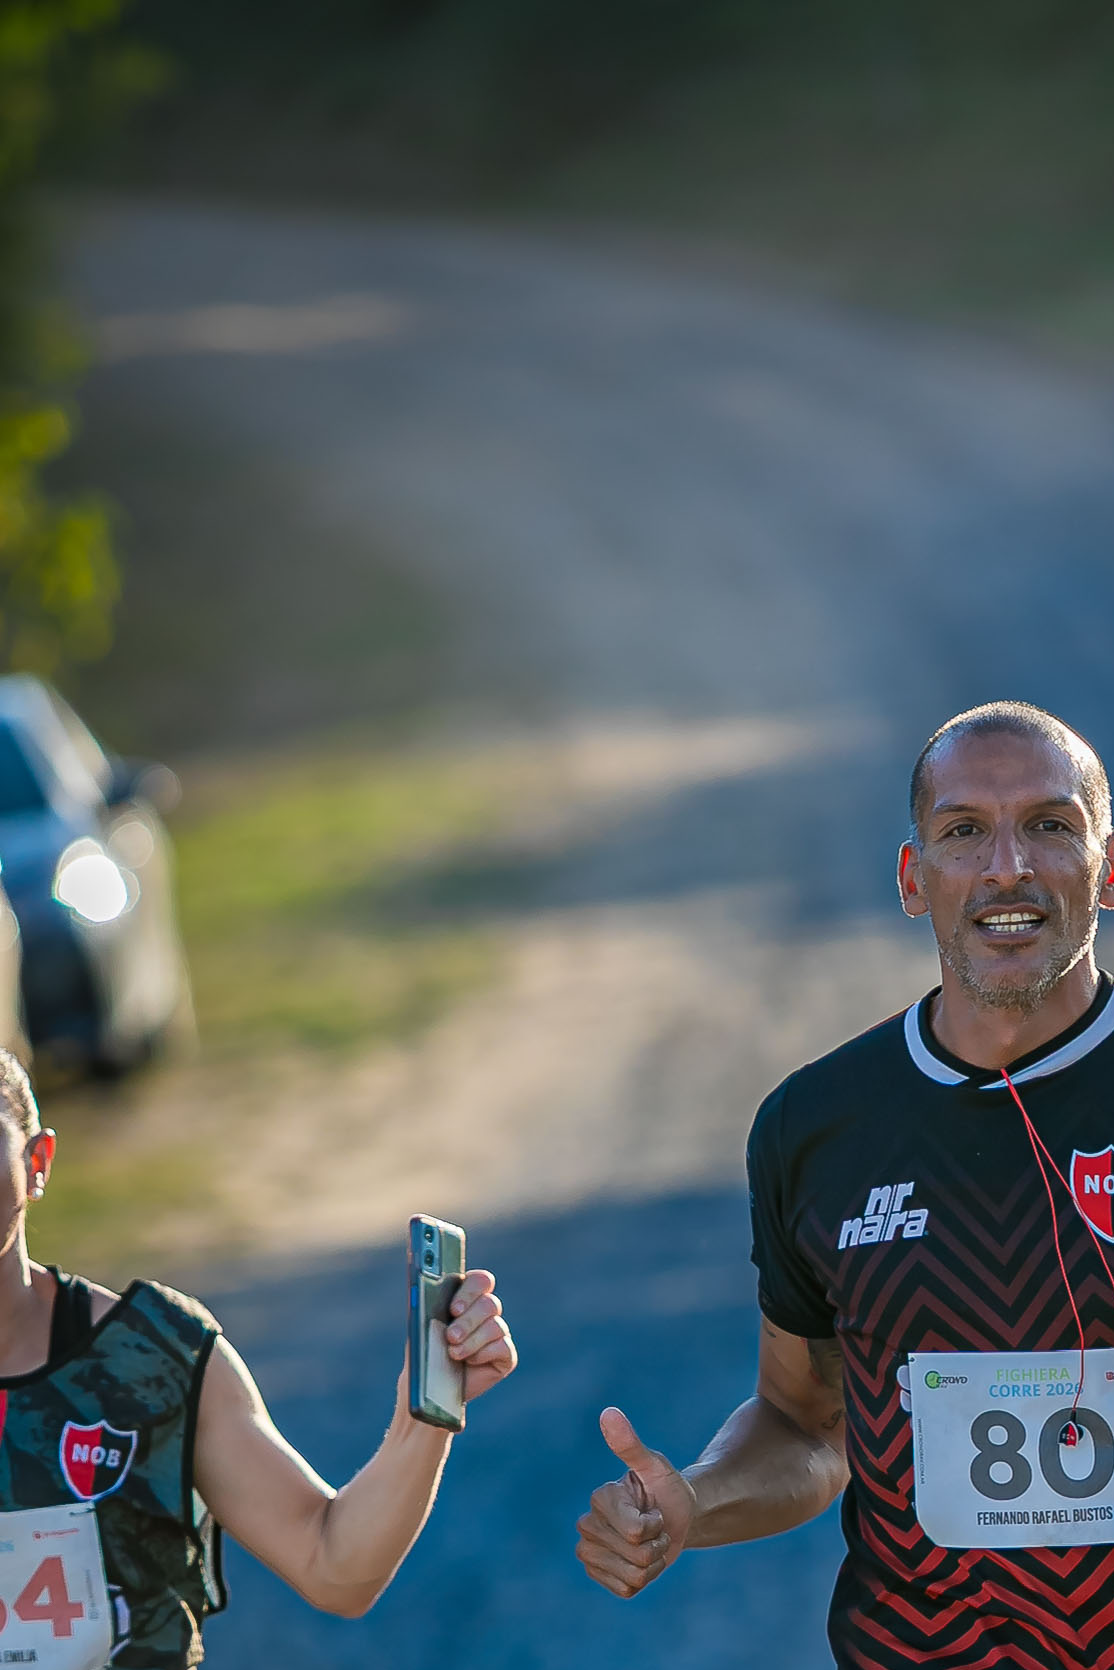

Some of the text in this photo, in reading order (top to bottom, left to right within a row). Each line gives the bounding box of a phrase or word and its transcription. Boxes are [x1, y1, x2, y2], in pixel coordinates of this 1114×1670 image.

[838, 1208, 929, 1250] nara
[996, 1368, 1071, 1382] FIGHIERA
[989, 1384, 1041, 1397] CORRE
[72, 1443, 121, 1468] NOB
[977, 1506, 1114, 1525] FERNANDO RAFAEL BUSTOS
[0, 1556, 84, 1637] 4
